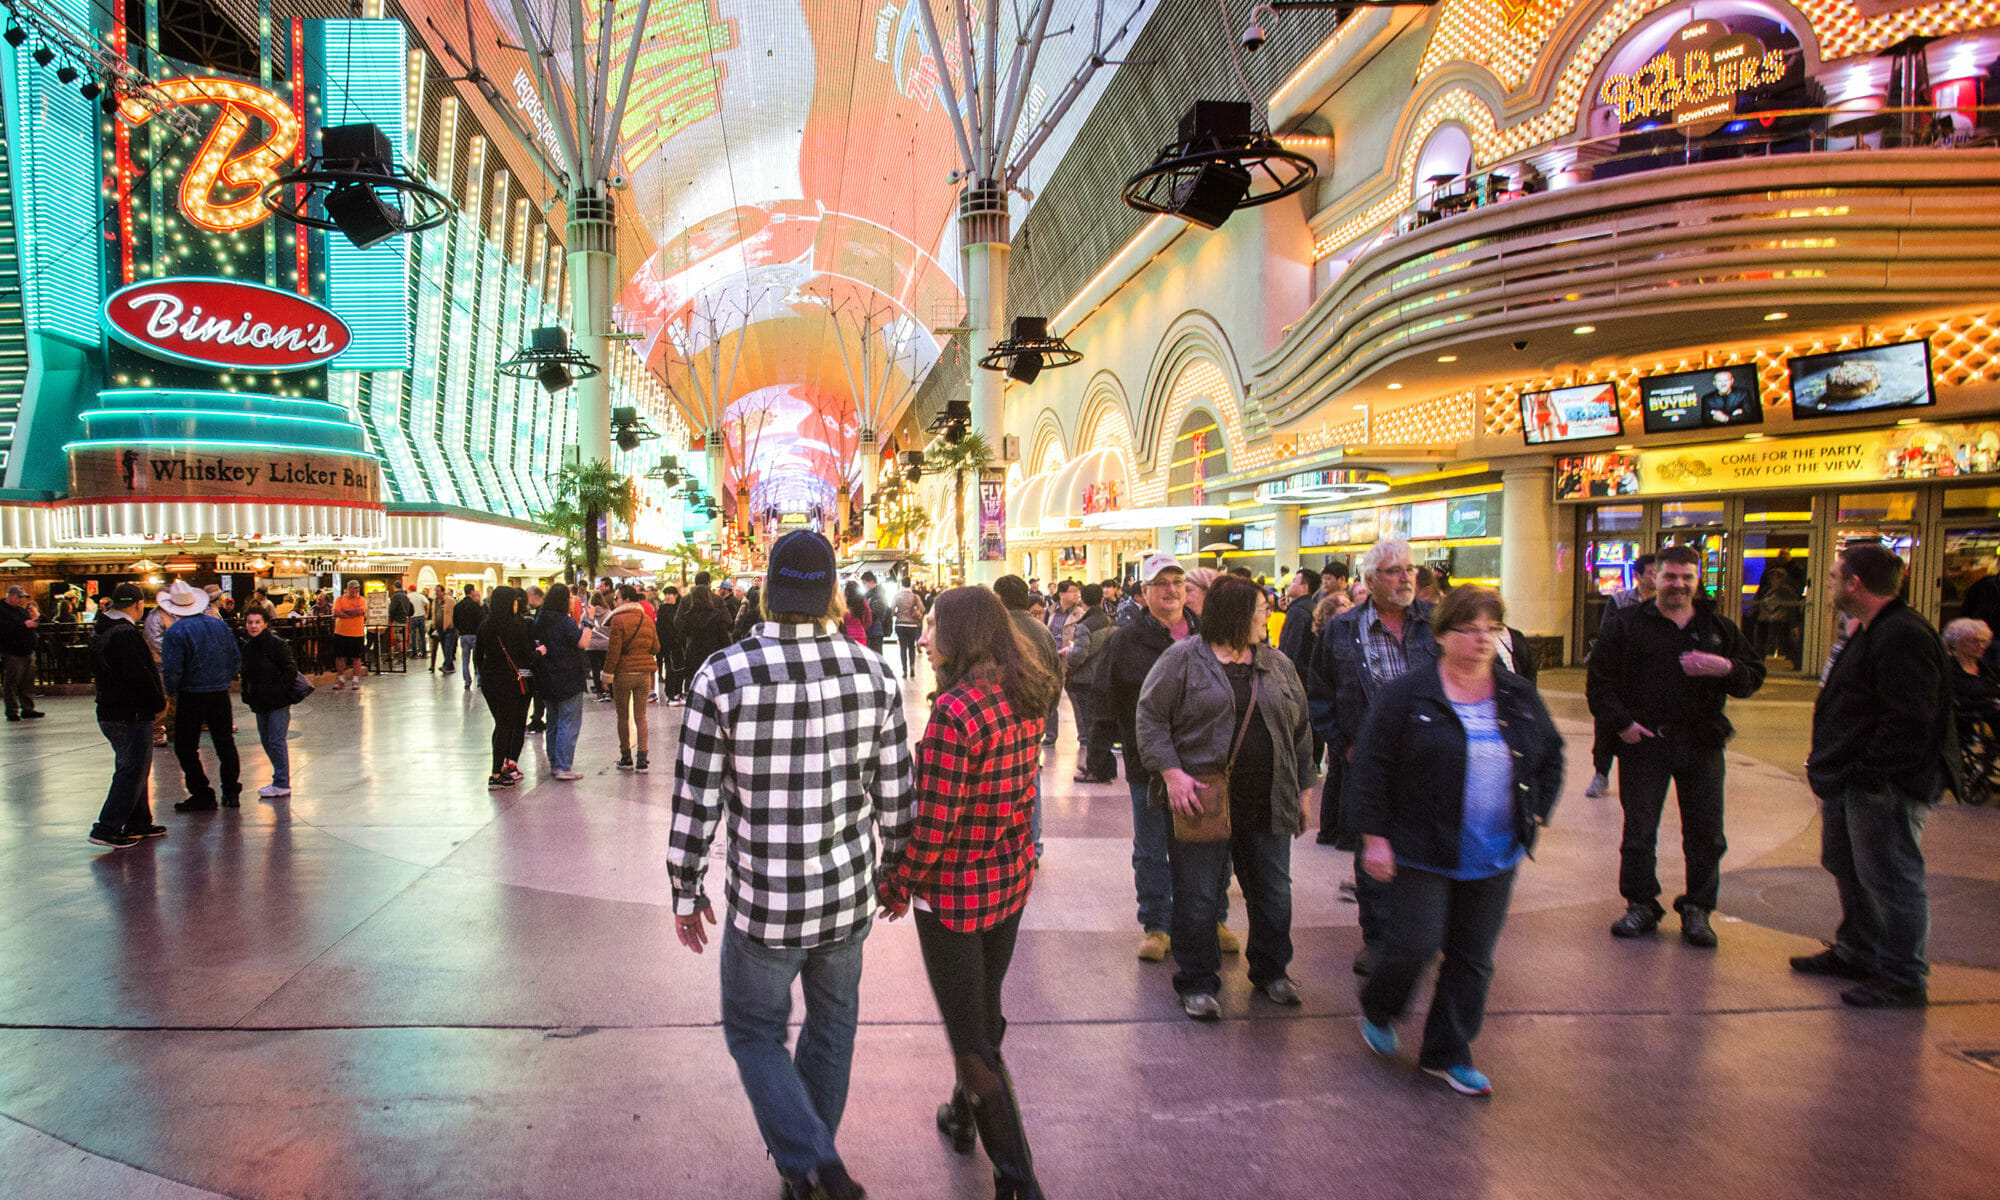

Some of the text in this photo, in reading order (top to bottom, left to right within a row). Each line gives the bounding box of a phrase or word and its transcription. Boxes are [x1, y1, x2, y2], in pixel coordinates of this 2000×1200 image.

[1682, 23, 1708, 41] DRINK
[1714, 44, 1745, 62] DANCE
[1600, 50, 1711, 104] GOLD
[1619, 50, 1787, 124] DIGGERS
[1677, 101, 1731, 124] DOWNTOWN
[127, 292, 335, 355] Binion's
[1649, 391, 1698, 412] BUYER
[1721, 444, 1865, 466] COME FOR THE PARTY,
[150, 458, 368, 489] Whiskey Licker Bar
[1734, 459, 1864, 478] STAY FOR THE VIEW.
[980, 484, 1005, 500] FLY
[779, 567, 827, 580] BAUER
